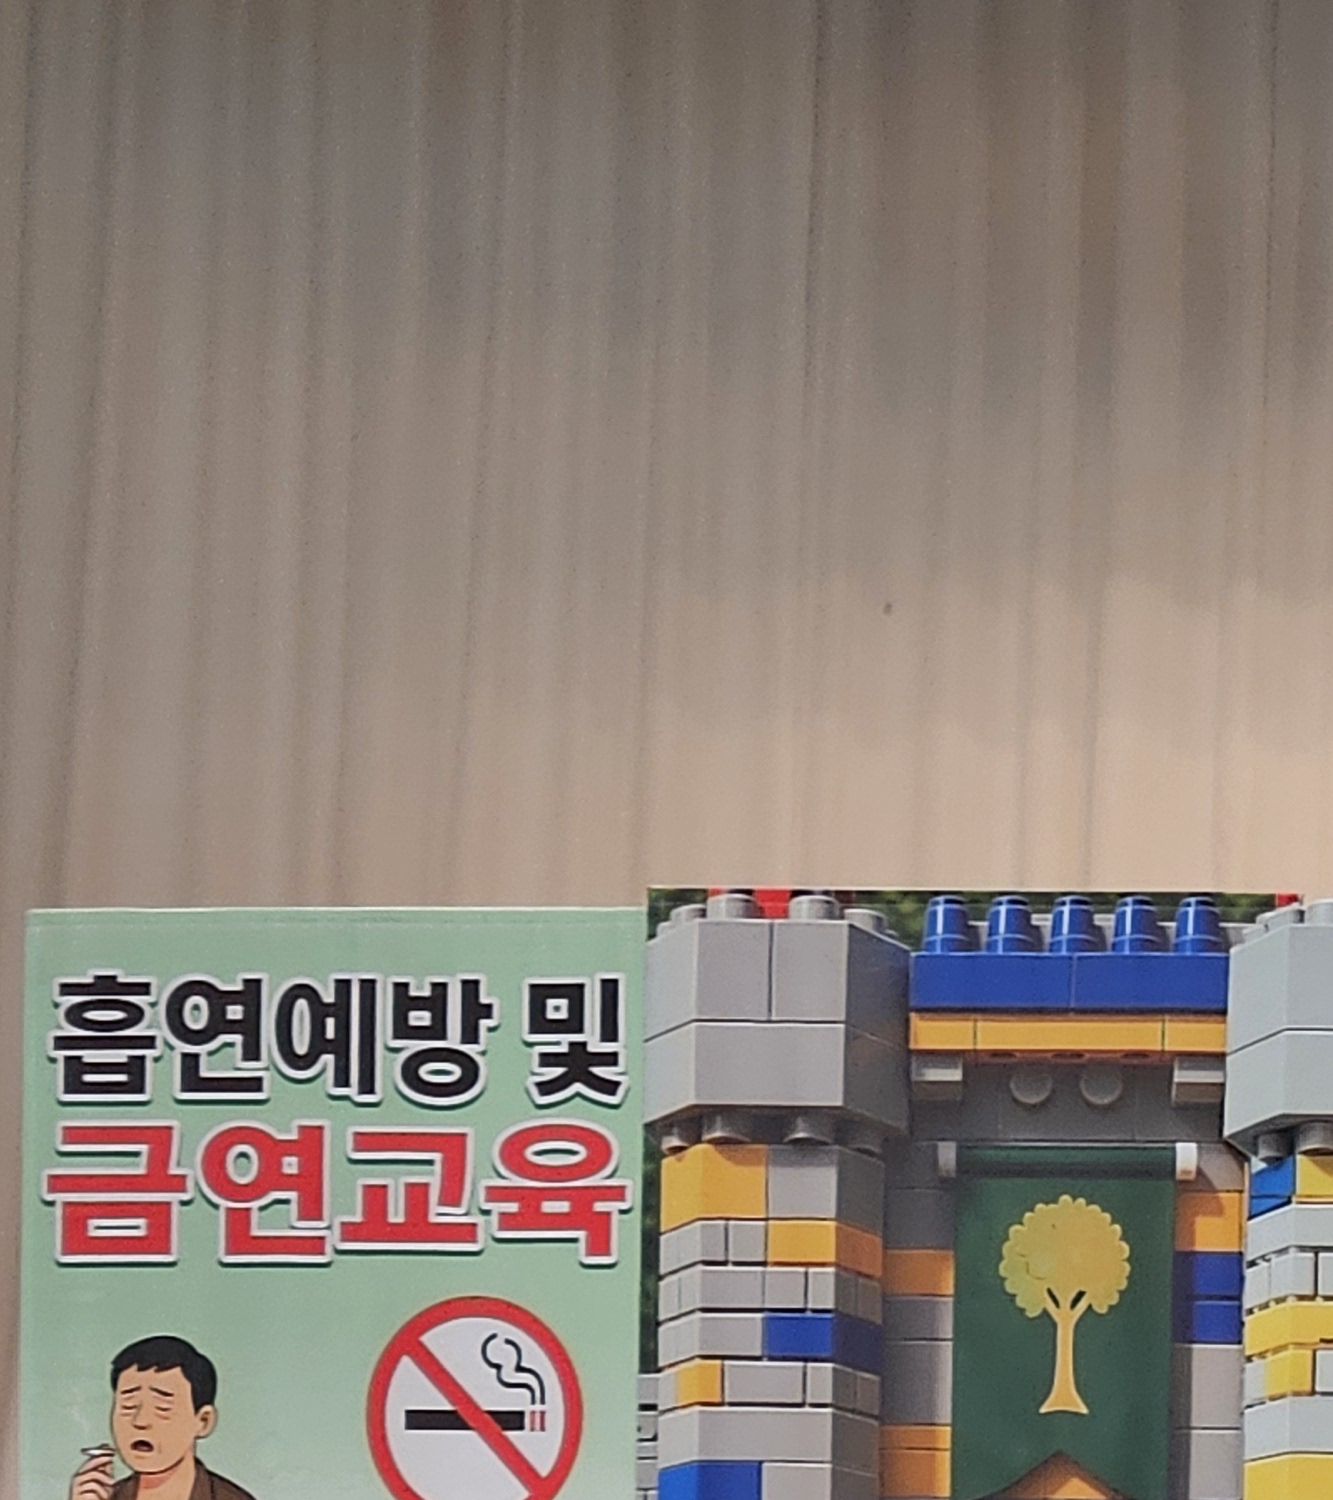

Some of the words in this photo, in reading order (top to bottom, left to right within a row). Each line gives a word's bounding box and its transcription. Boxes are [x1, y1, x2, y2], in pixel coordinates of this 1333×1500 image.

[51, 973, 498, 1103] 흡연예방
[524, 975, 628, 1102] 및
[44, 1121, 631, 1263] 금연교육
